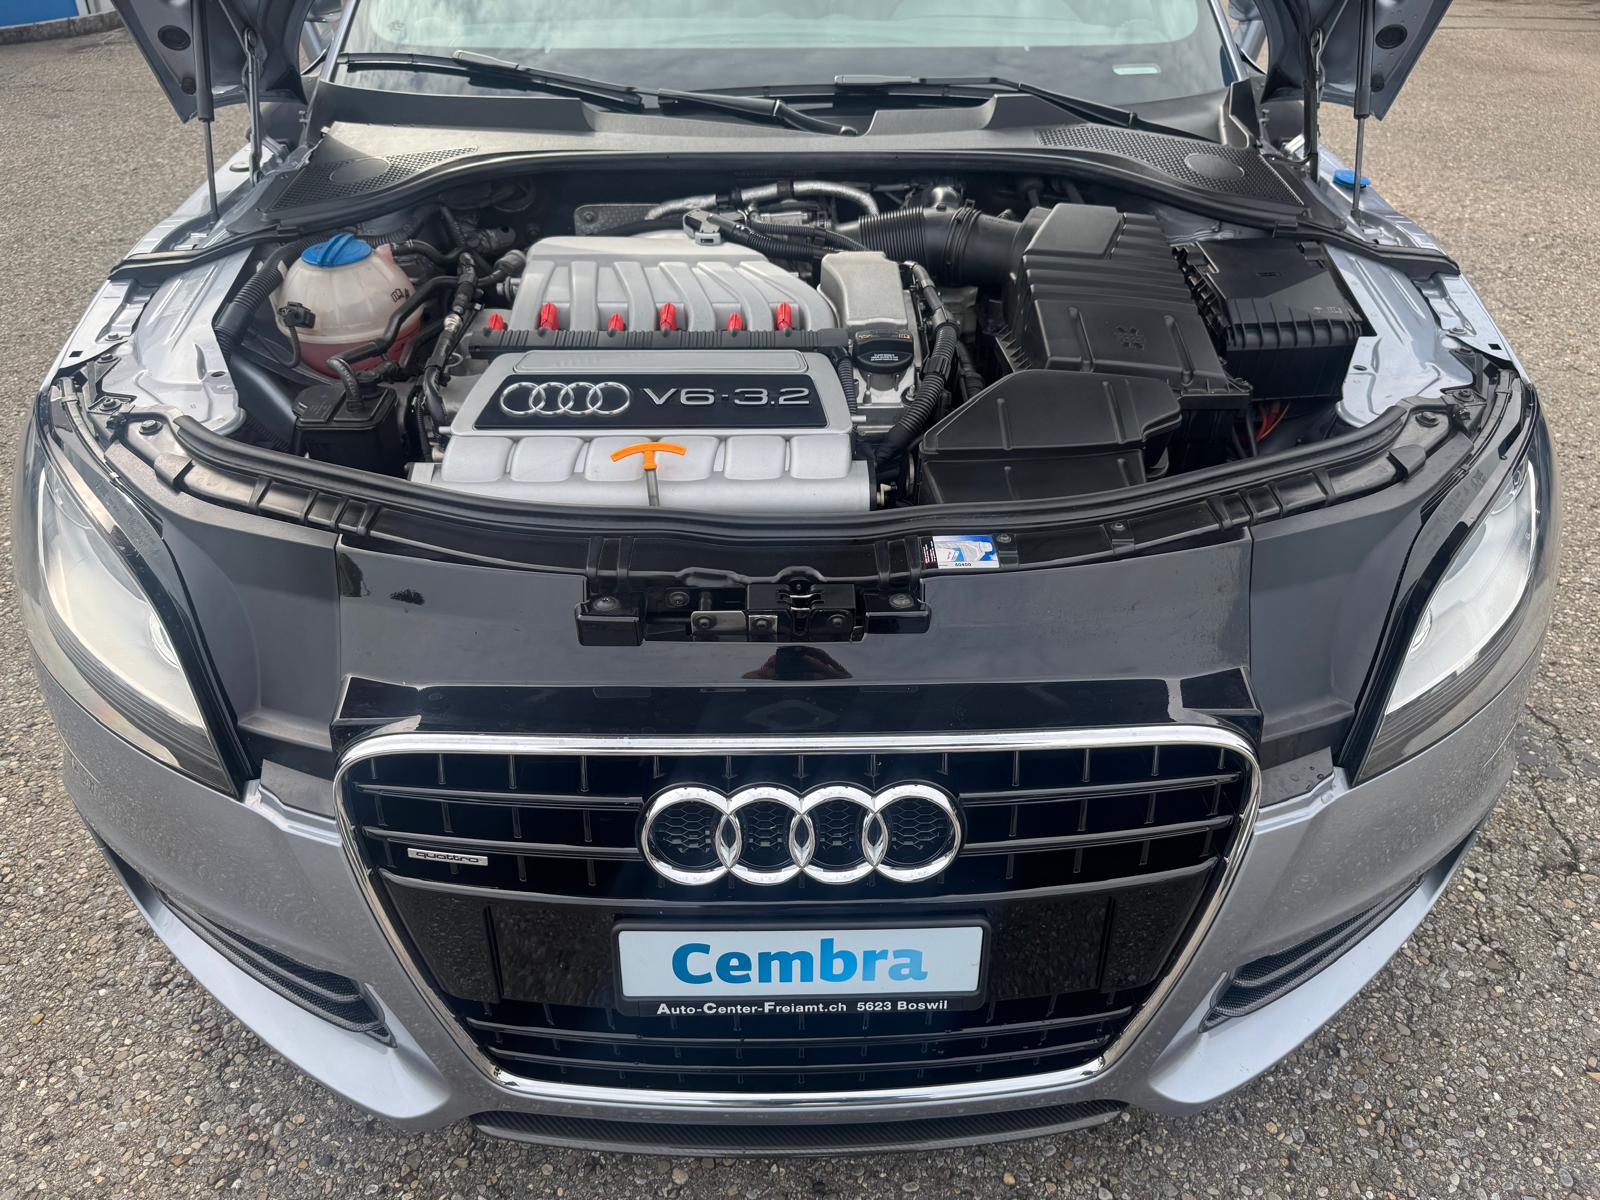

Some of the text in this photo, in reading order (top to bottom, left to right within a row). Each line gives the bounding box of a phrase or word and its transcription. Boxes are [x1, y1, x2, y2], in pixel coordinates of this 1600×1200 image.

[415, 851, 479, 863] quattro
[671, 937, 929, 985] Cembra
[656, 1000, 949, 1015] Auto-Center-Freiamt.ch 5623 Boswil
